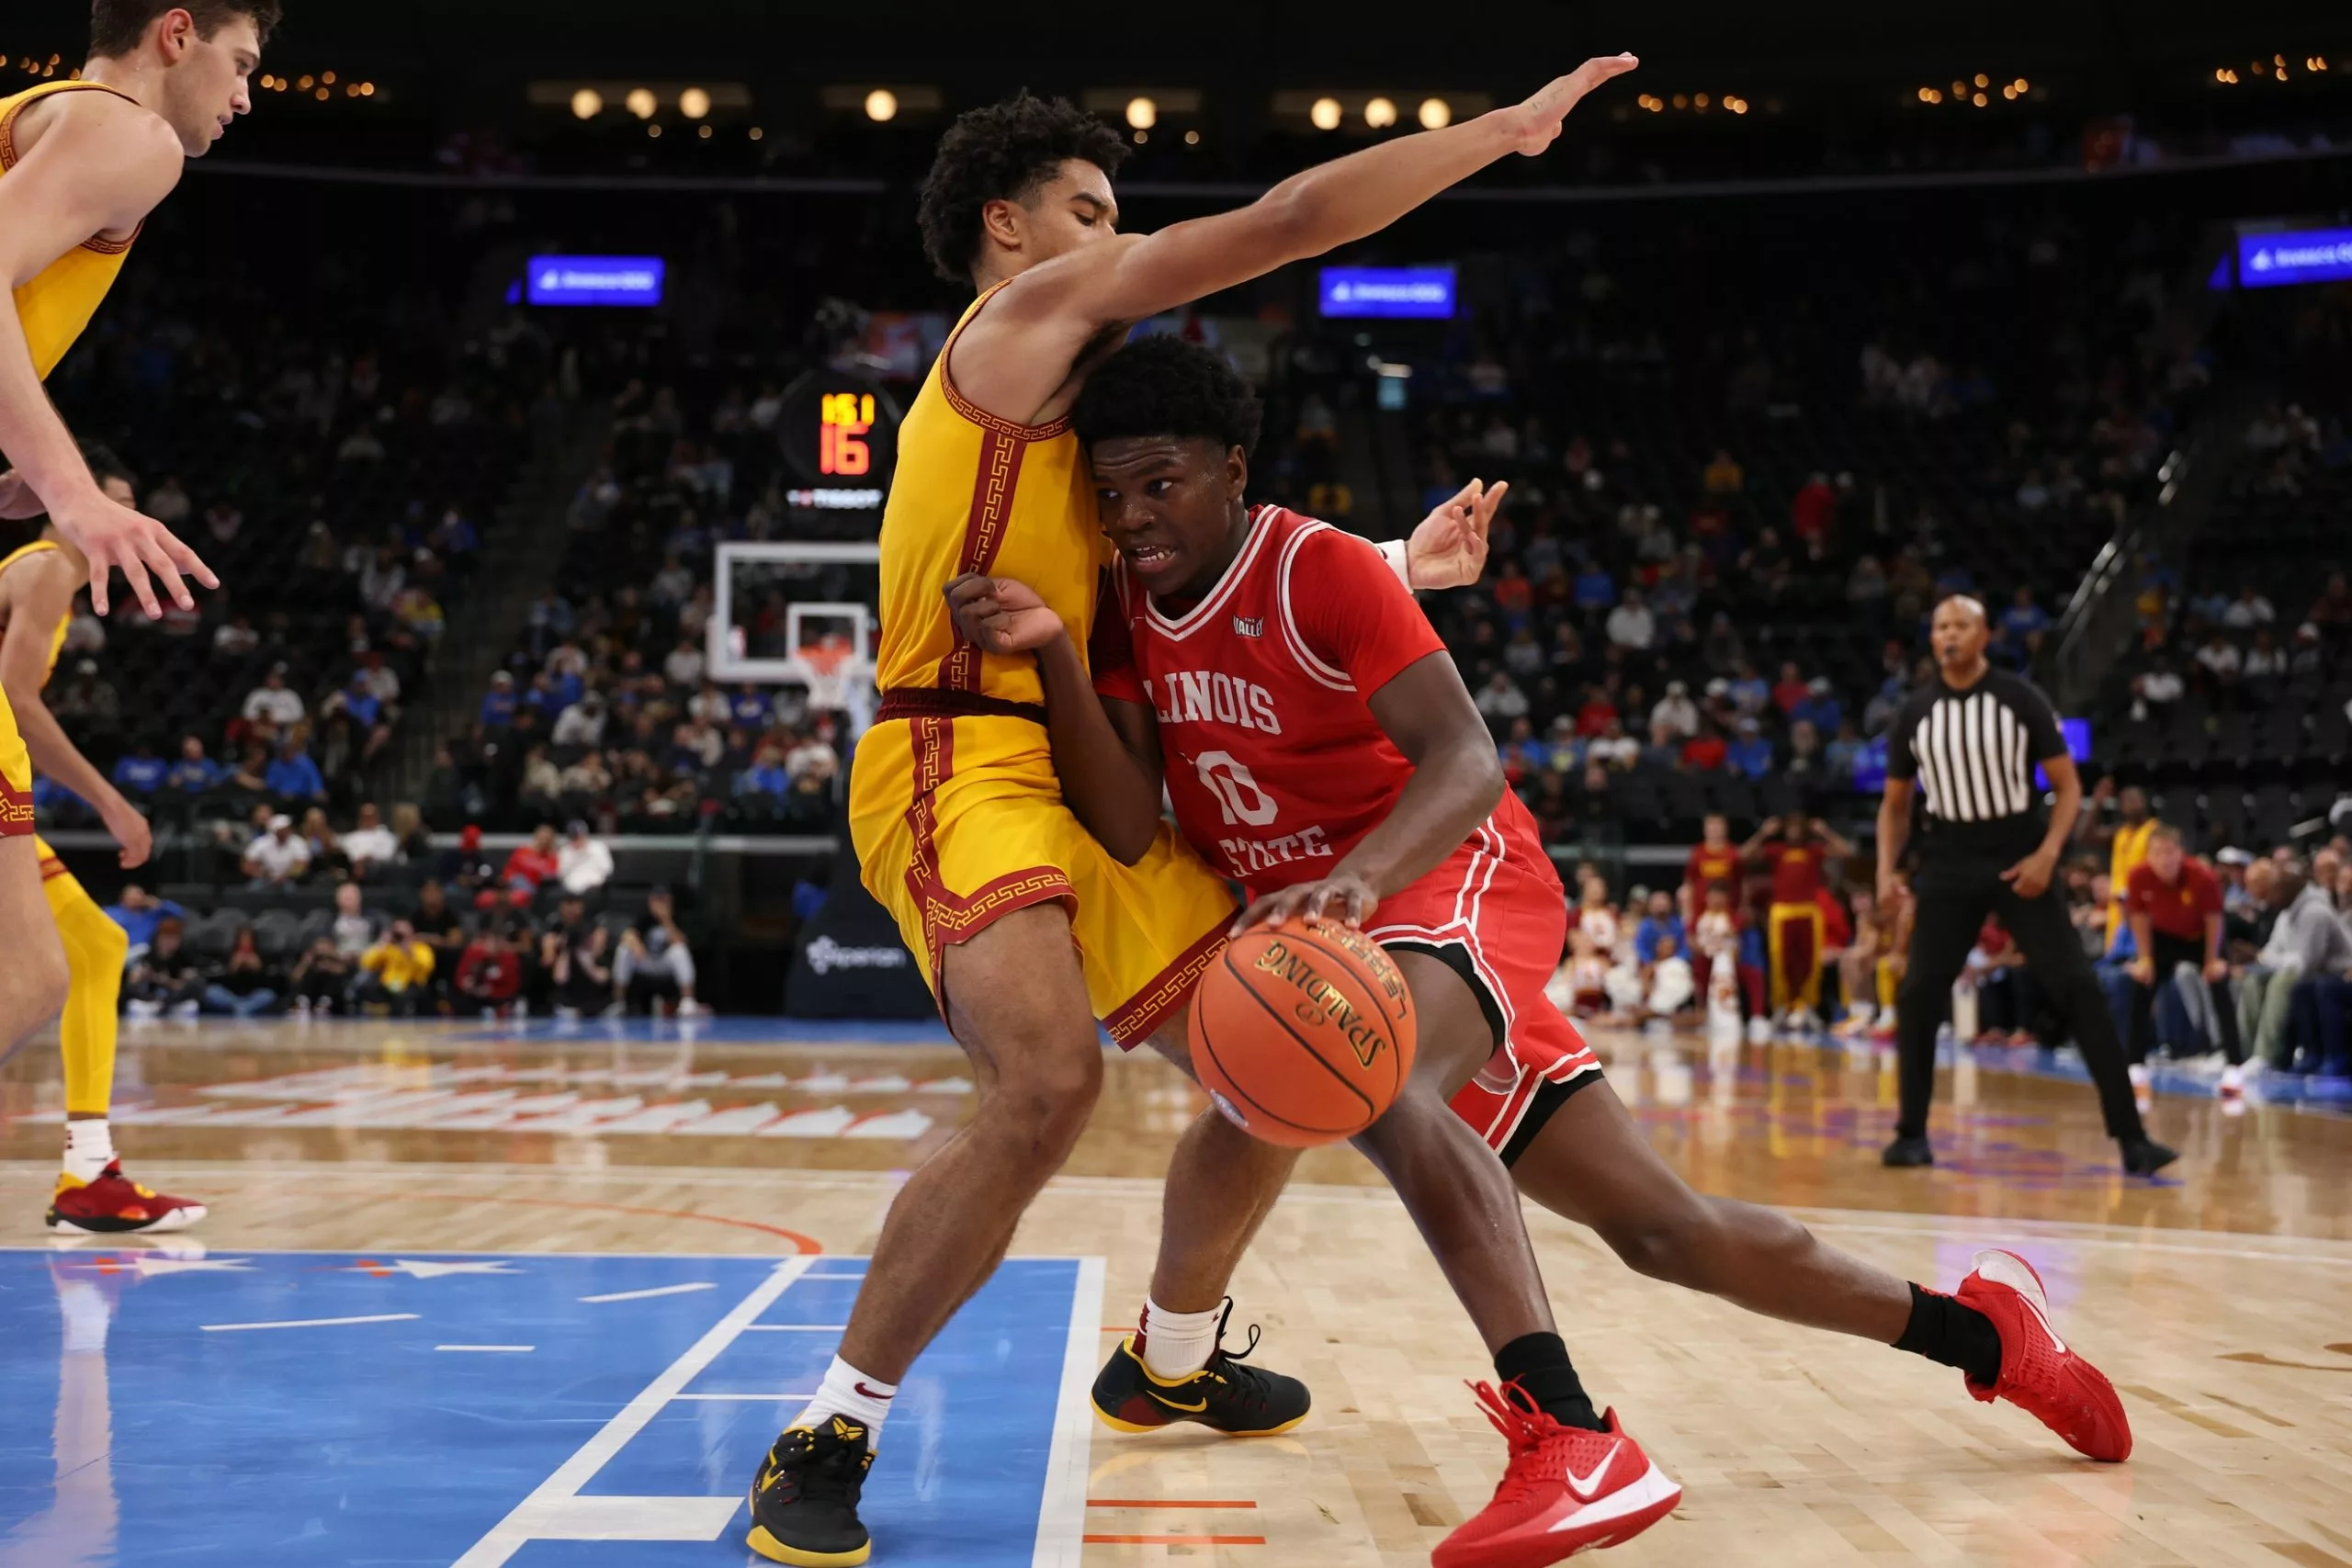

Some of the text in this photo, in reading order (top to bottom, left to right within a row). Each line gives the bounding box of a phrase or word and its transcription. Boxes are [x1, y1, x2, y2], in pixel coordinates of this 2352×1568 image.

[820, 422, 870, 475] 16
[1233, 615, 1264, 637] VALLEY
[1143, 670, 1282, 736] LINOIS
[1195, 750, 1279, 827] 0
[1218, 824, 1334, 878] STATE
[1254, 938, 1386, 1071] SPALDING
